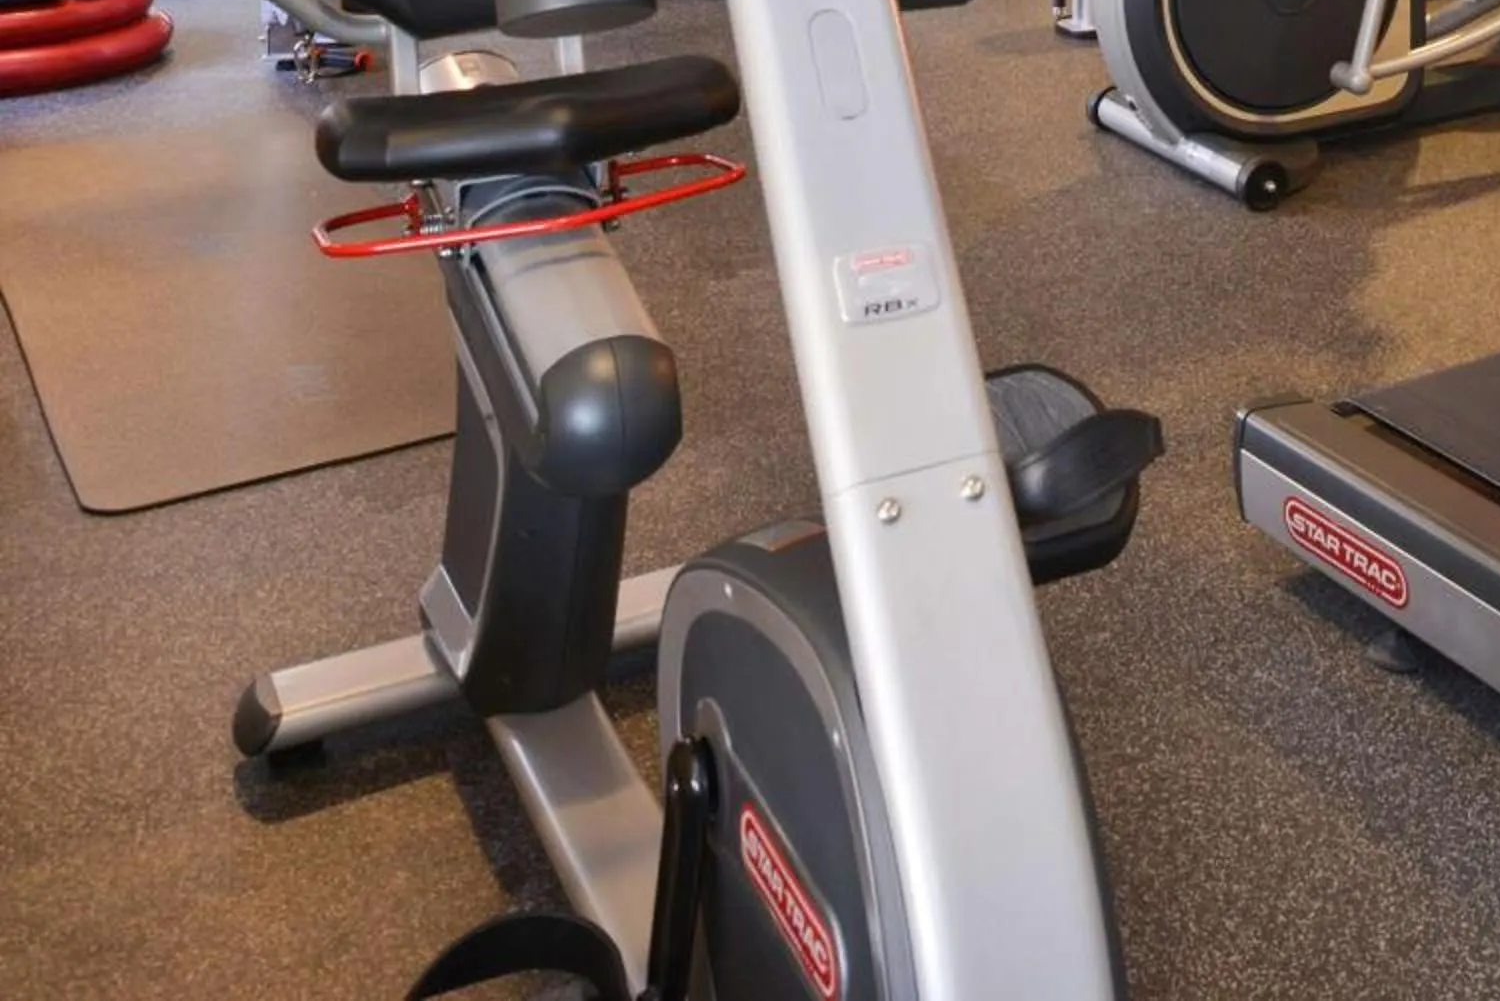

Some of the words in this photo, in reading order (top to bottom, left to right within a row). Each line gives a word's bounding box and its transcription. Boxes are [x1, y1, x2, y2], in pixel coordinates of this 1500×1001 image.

[1291, 512, 1341, 556] STAR
[1341, 542, 1397, 591] TRAC
[747, 829, 785, 904] STAR
[783, 885, 828, 975] TRAC
